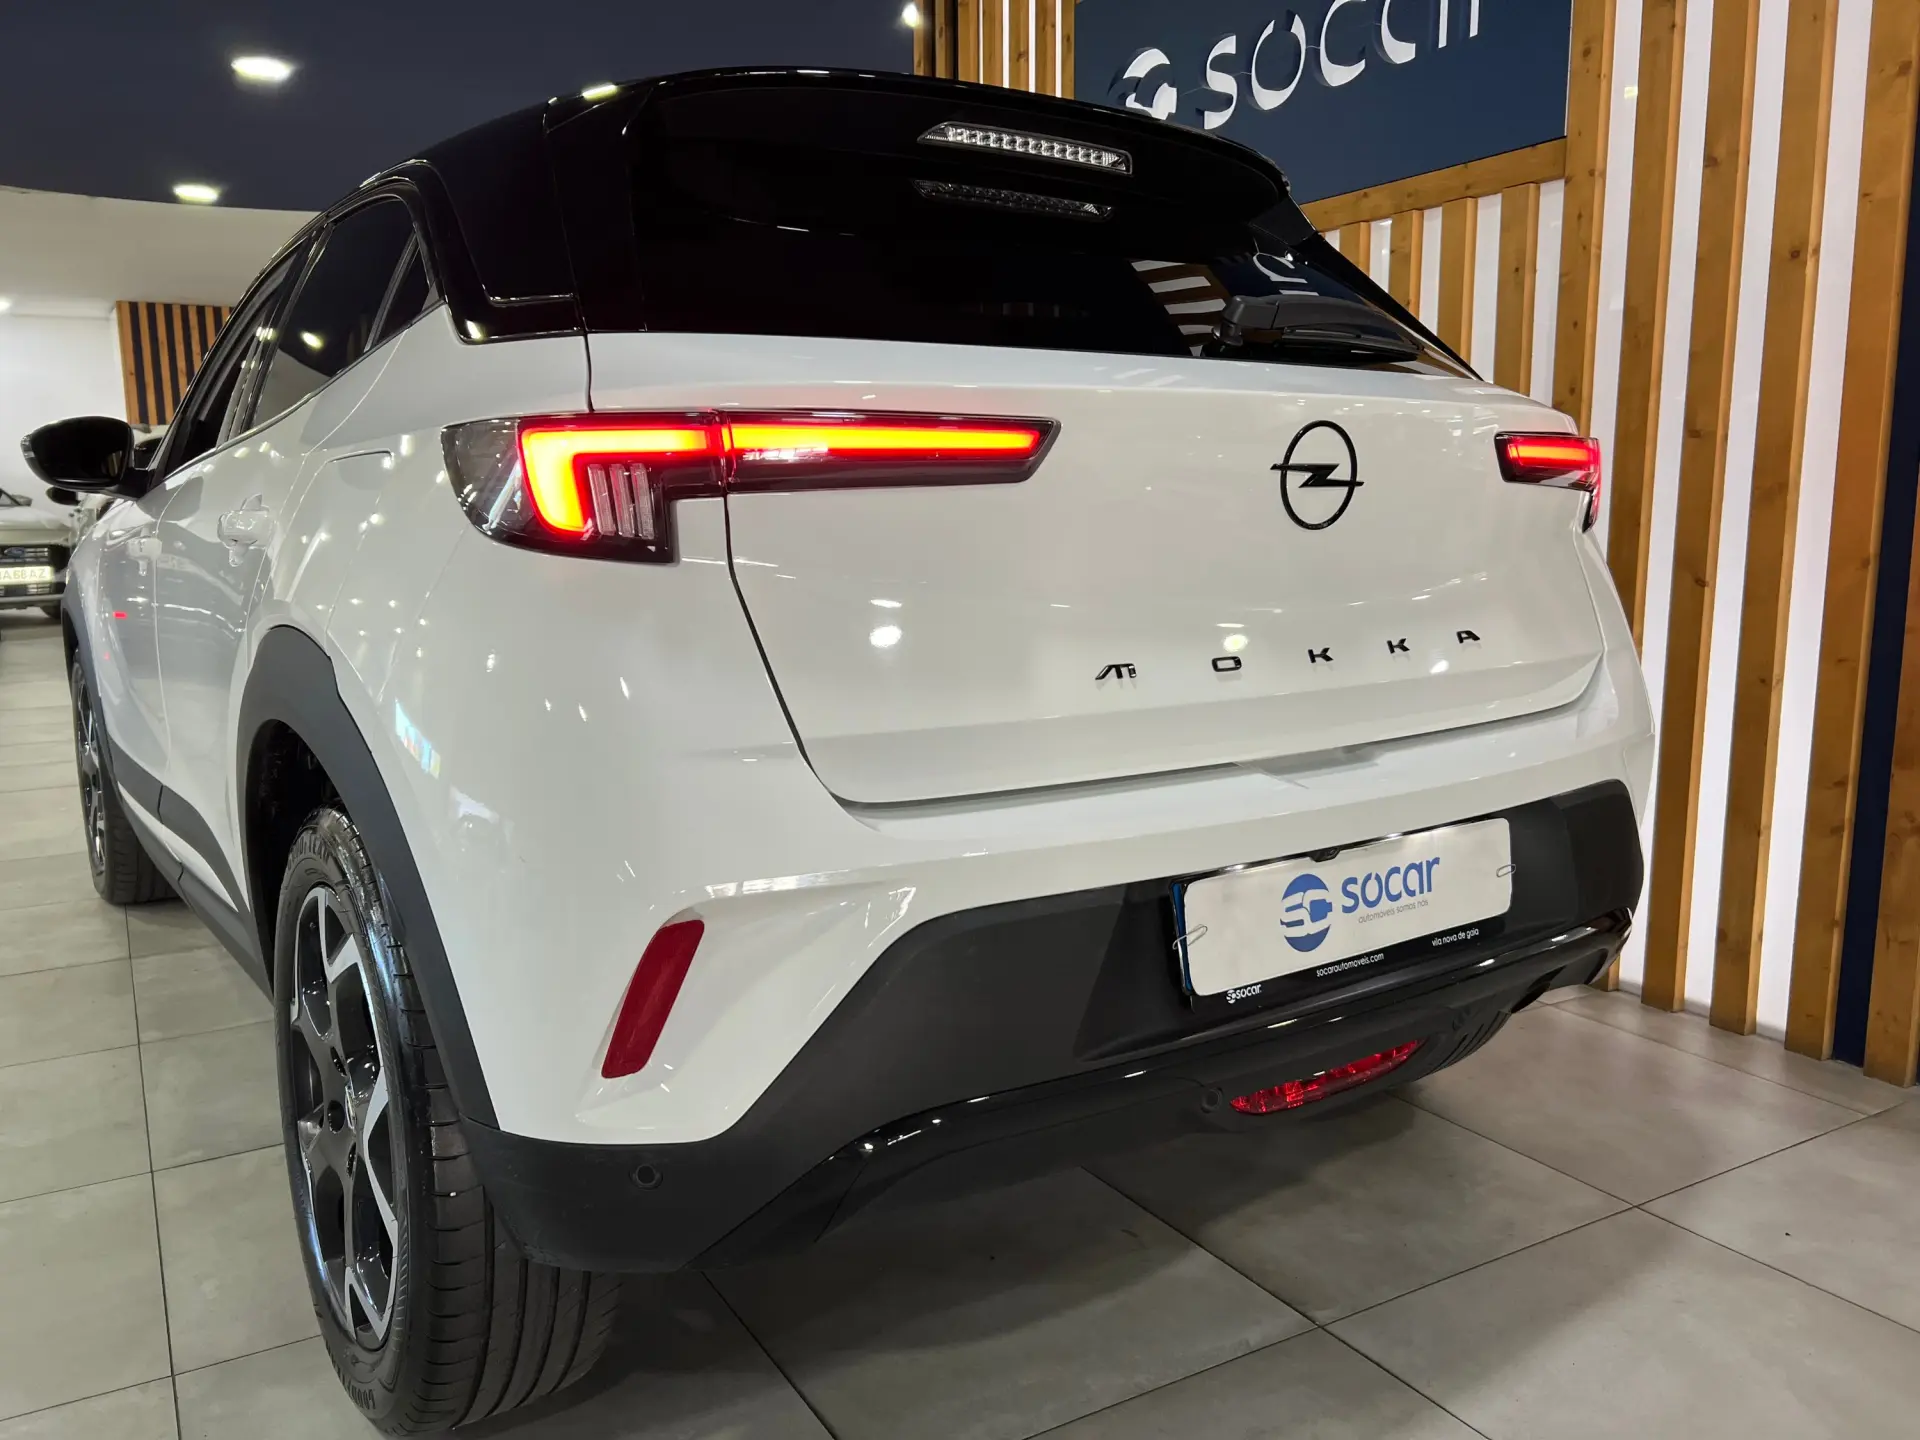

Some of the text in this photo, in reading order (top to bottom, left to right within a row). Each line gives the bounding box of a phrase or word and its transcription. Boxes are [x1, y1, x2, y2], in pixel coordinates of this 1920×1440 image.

[1094, 629, 1481, 681] MOKKA
[1341, 857, 1440, 913] socar
[1431, 927, 1479, 946] vila nova de gaia
